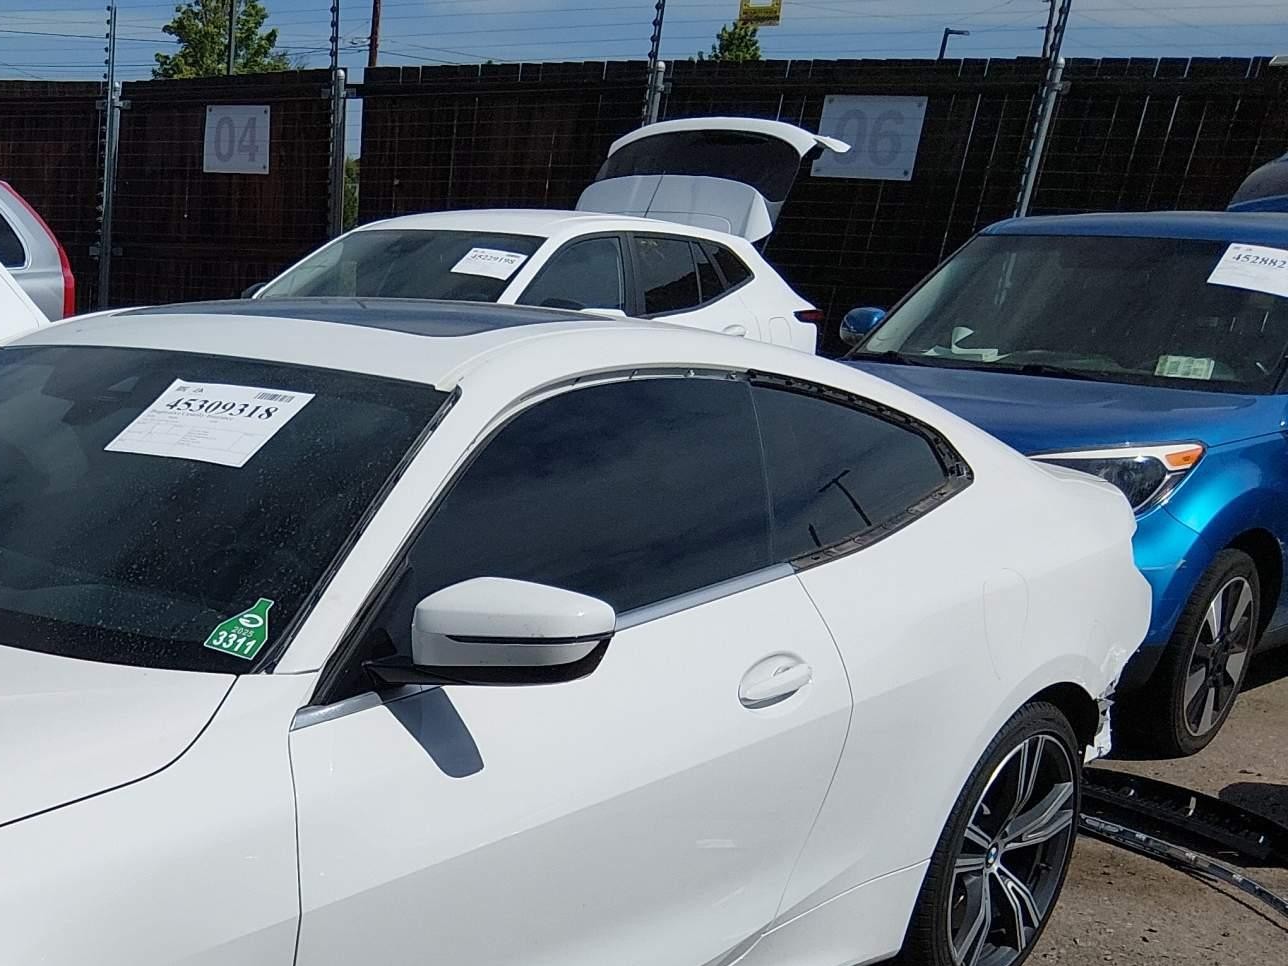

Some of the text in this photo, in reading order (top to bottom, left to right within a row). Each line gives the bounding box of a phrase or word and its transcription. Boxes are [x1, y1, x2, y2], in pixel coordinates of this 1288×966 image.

[214, 116, 259, 162] 04
[832, 109, 905, 166] 06
[166, 396, 280, 421] 45309318
[212, 630, 257, 655] 3311
[231, 626, 255, 637] 2025
